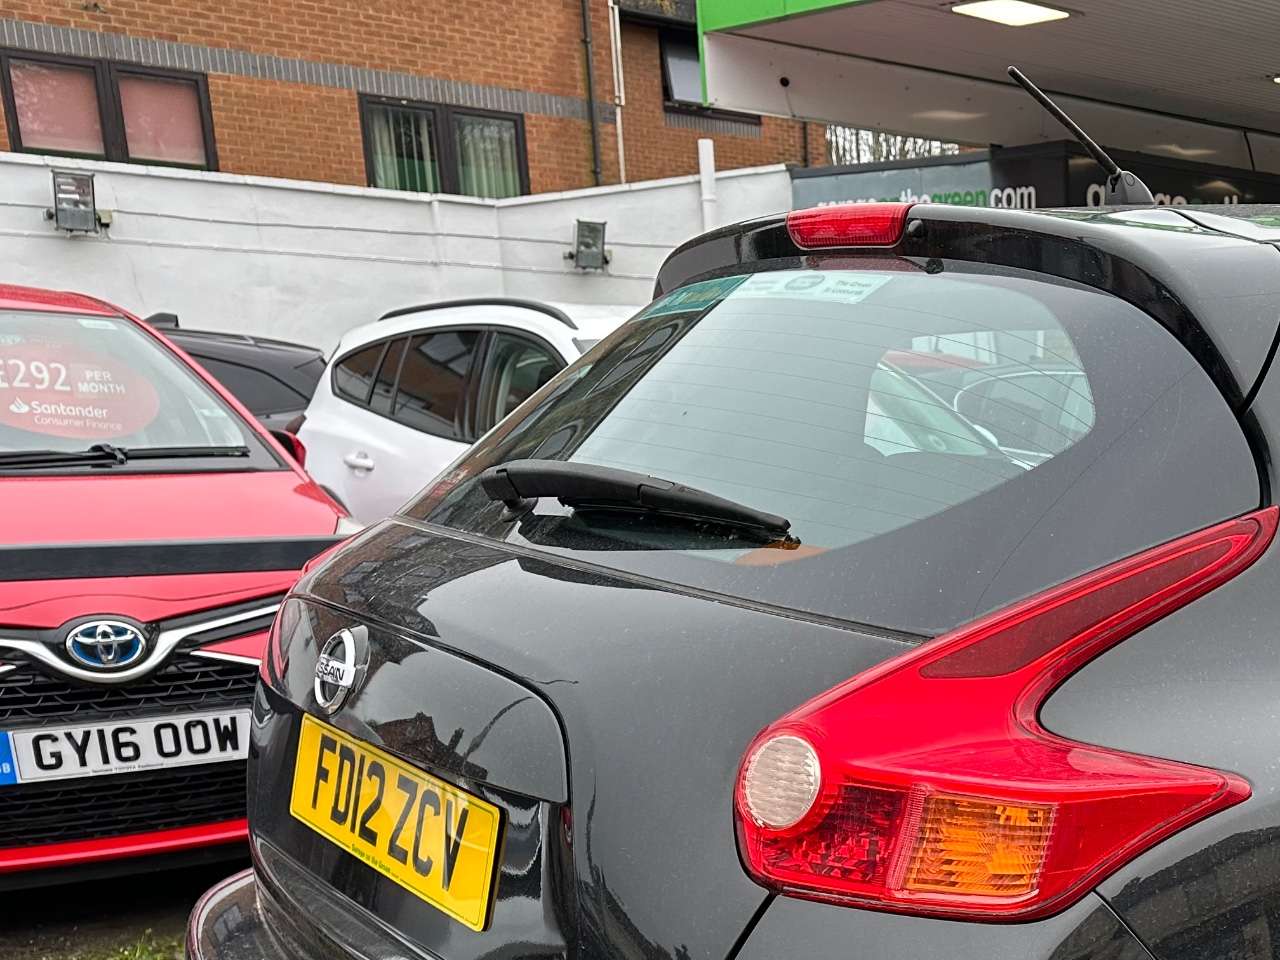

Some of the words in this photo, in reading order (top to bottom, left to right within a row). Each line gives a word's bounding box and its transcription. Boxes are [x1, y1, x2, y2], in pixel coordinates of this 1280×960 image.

[85, 370, 112, 381] PER
[77, 382, 126, 394] MONTH
[30, 401, 108, 418] Santander
[33, 415, 83, 427] Consumer
[86, 419, 122, 431] Finance
[32, 726, 141, 771] GY16
[153, 716, 240, 759] OOW
[312, 733, 386, 847] FD12
[387, 773, 469, 891] ZCV
